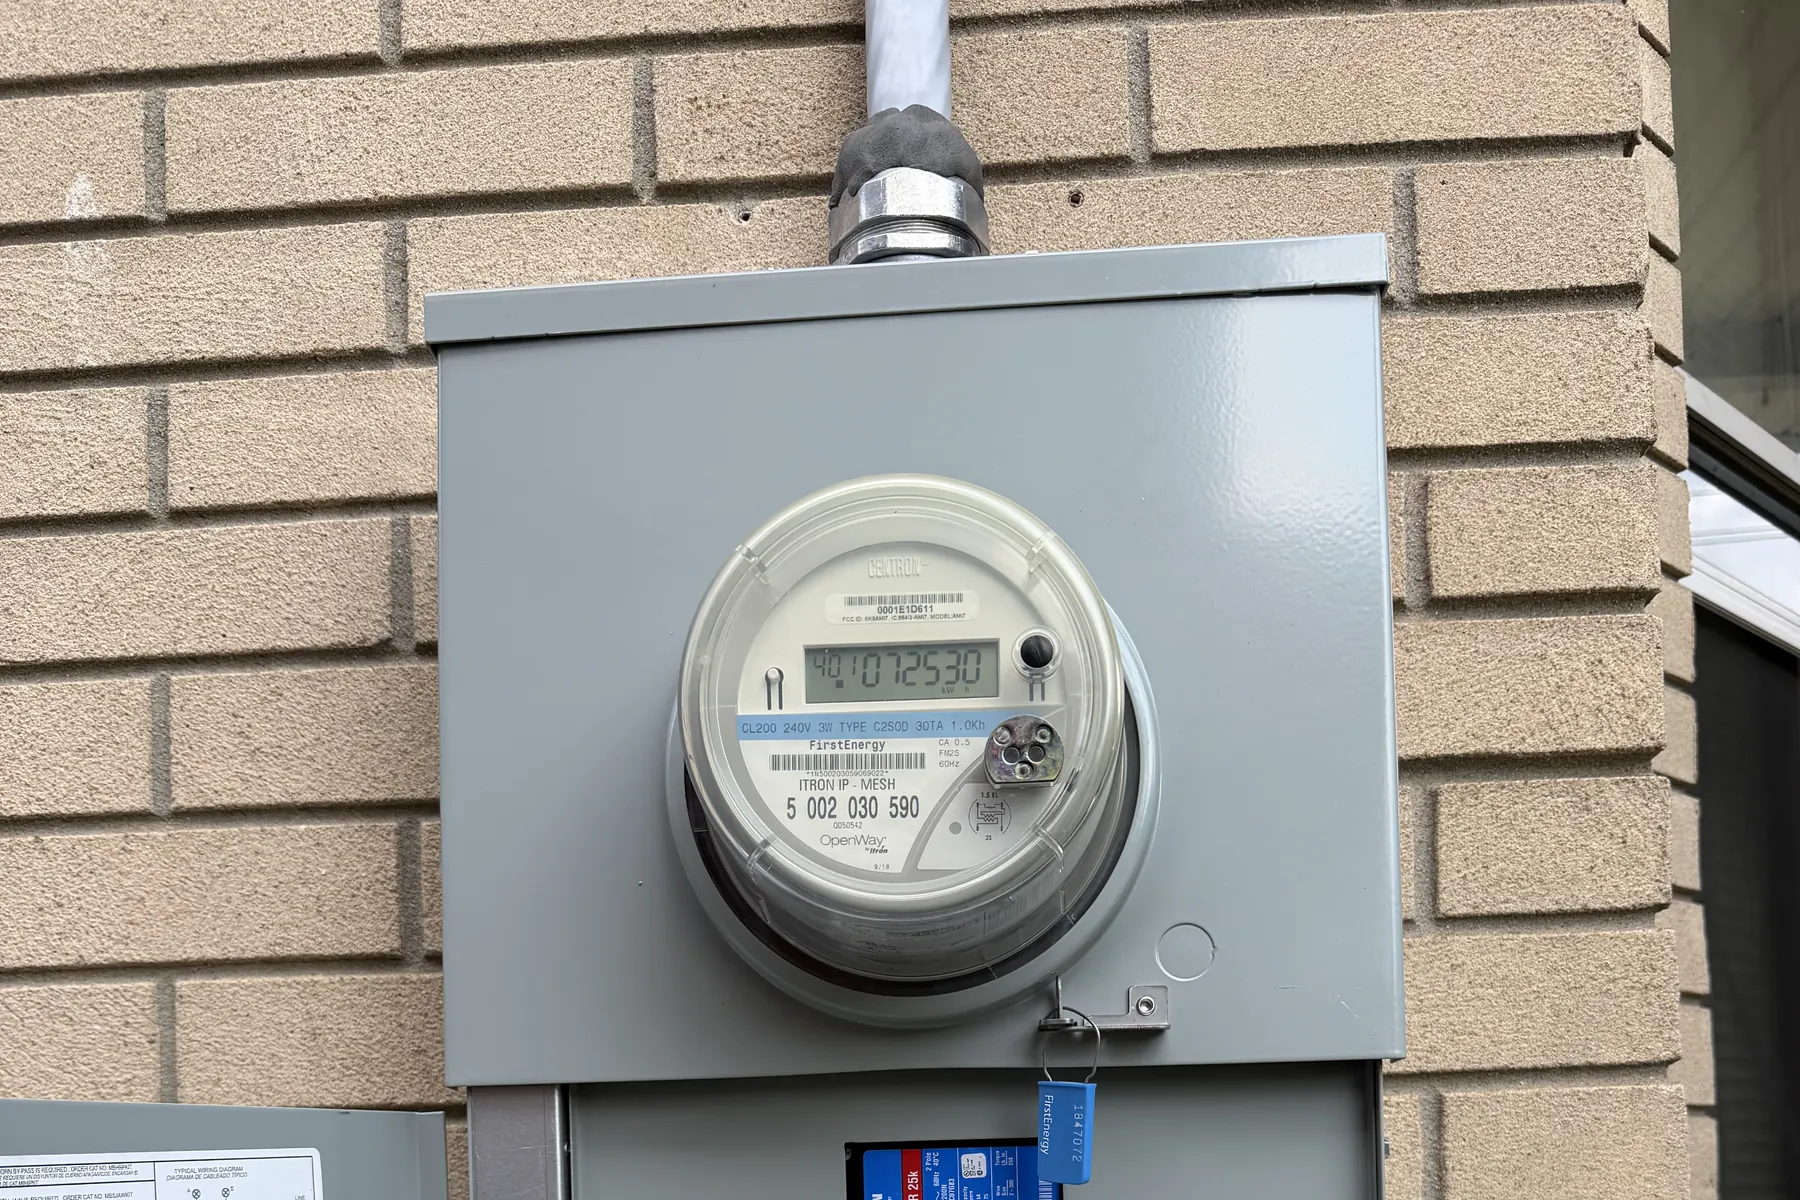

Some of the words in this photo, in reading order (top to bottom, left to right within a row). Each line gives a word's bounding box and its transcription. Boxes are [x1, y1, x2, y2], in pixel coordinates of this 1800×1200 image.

[868, 556, 921, 578] CENTRON
[877, 605, 934, 614] 0001E1D611
[861, 649, 981, 688] 072530
[742, 722, 777, 734] CL200
[783, 722, 812, 733] 240V
[818, 722, 833, 733] 3W
[839, 721, 867, 732] TYPE
[916, 720, 944, 731] 30TA
[952, 720, 985, 731] 1.0Kh
[809, 740, 886, 752] FirstEnergy
[938, 738, 949, 746] CA
[954, 738, 970, 746] 0.5
[938, 749, 960, 757] FM2S
[938, 760, 960, 768] 60Hz
[799, 779, 835, 791] ITRON
[838, 779, 849, 791] IP
[860, 778, 896, 790] MESH
[786, 797, 796, 820] 5
[807, 796, 837, 819] 002
[848, 795, 878, 819] 030
[889, 795, 919, 818] 590
[820, 834, 885, 847] OpenWay
[1040, 1094, 1054, 1155] FirstEnergy
[1072, 1104, 1084, 1163] 1847072
[907, 1170, 919, 1192] 25k
